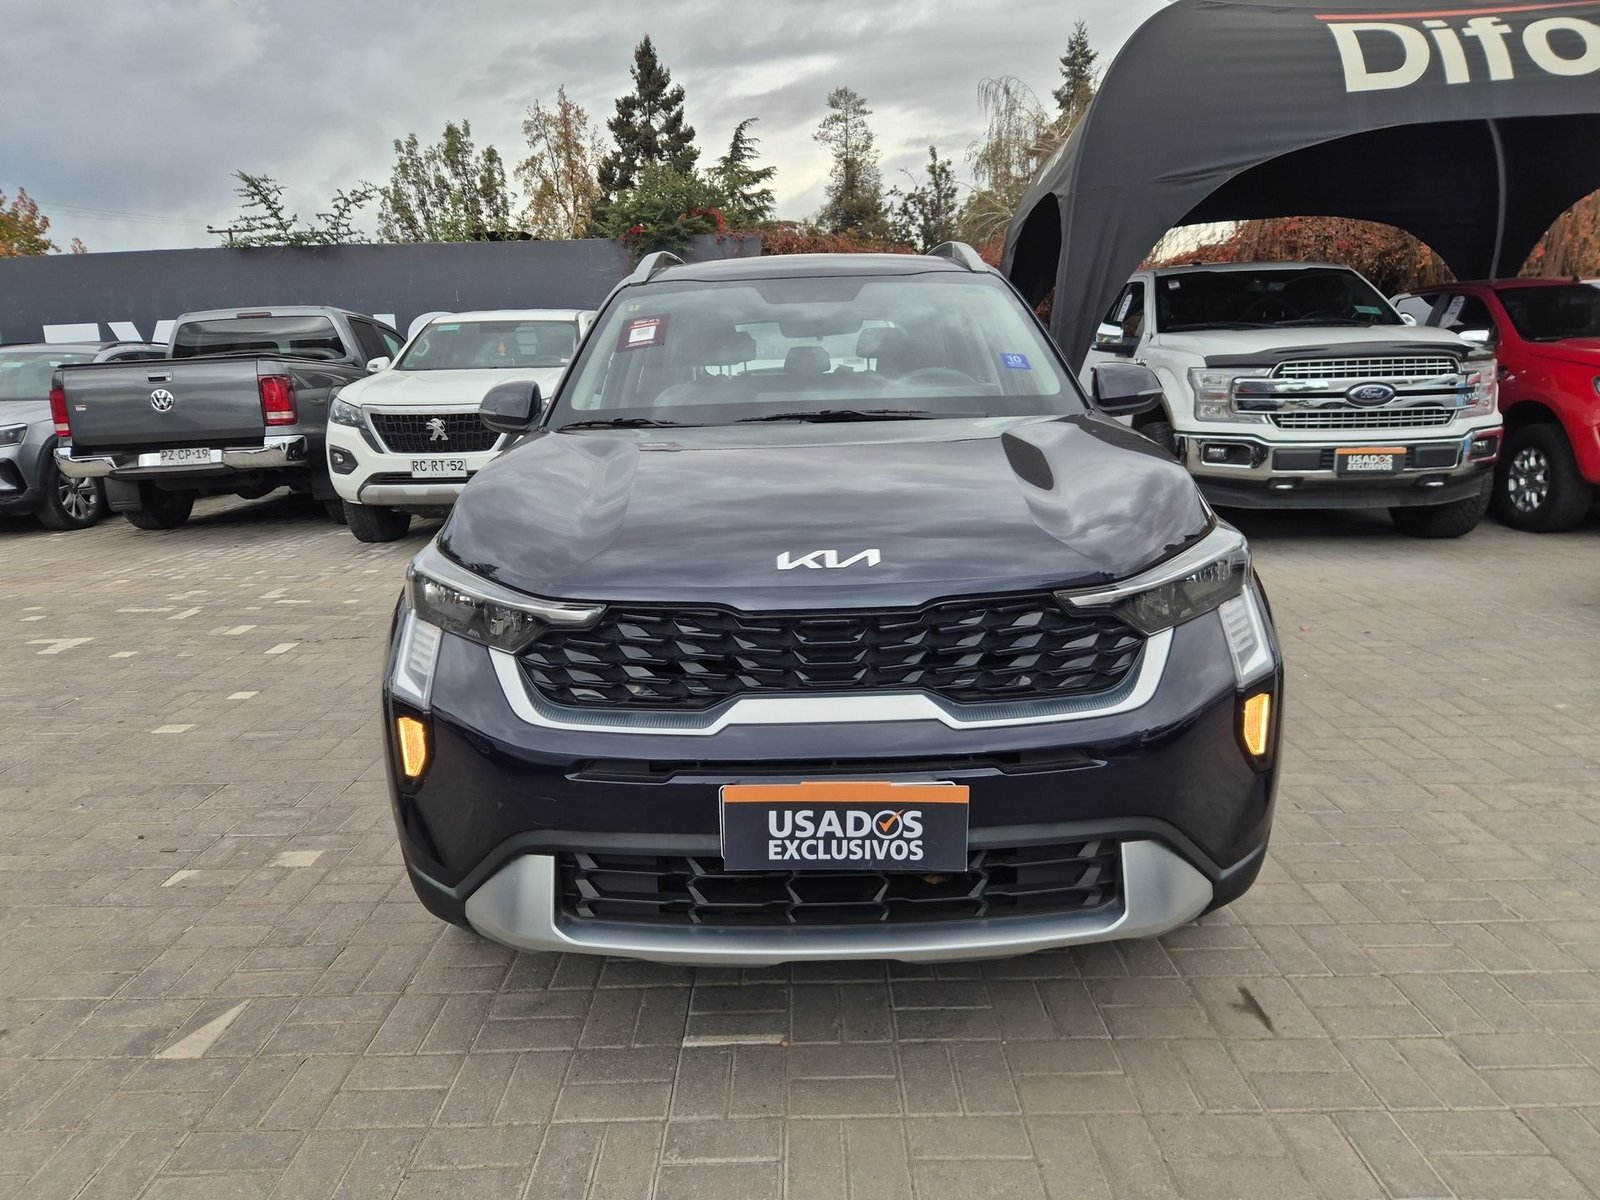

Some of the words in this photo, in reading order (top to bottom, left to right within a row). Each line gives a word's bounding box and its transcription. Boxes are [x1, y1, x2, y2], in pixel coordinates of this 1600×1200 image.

[1346, 462, 1393, 471] EXCLUSIVOS
[1347, 454, 1393, 464] USADOS
[768, 809, 923, 839] USADOS
[768, 839, 924, 861] EXCLUSIVOS
